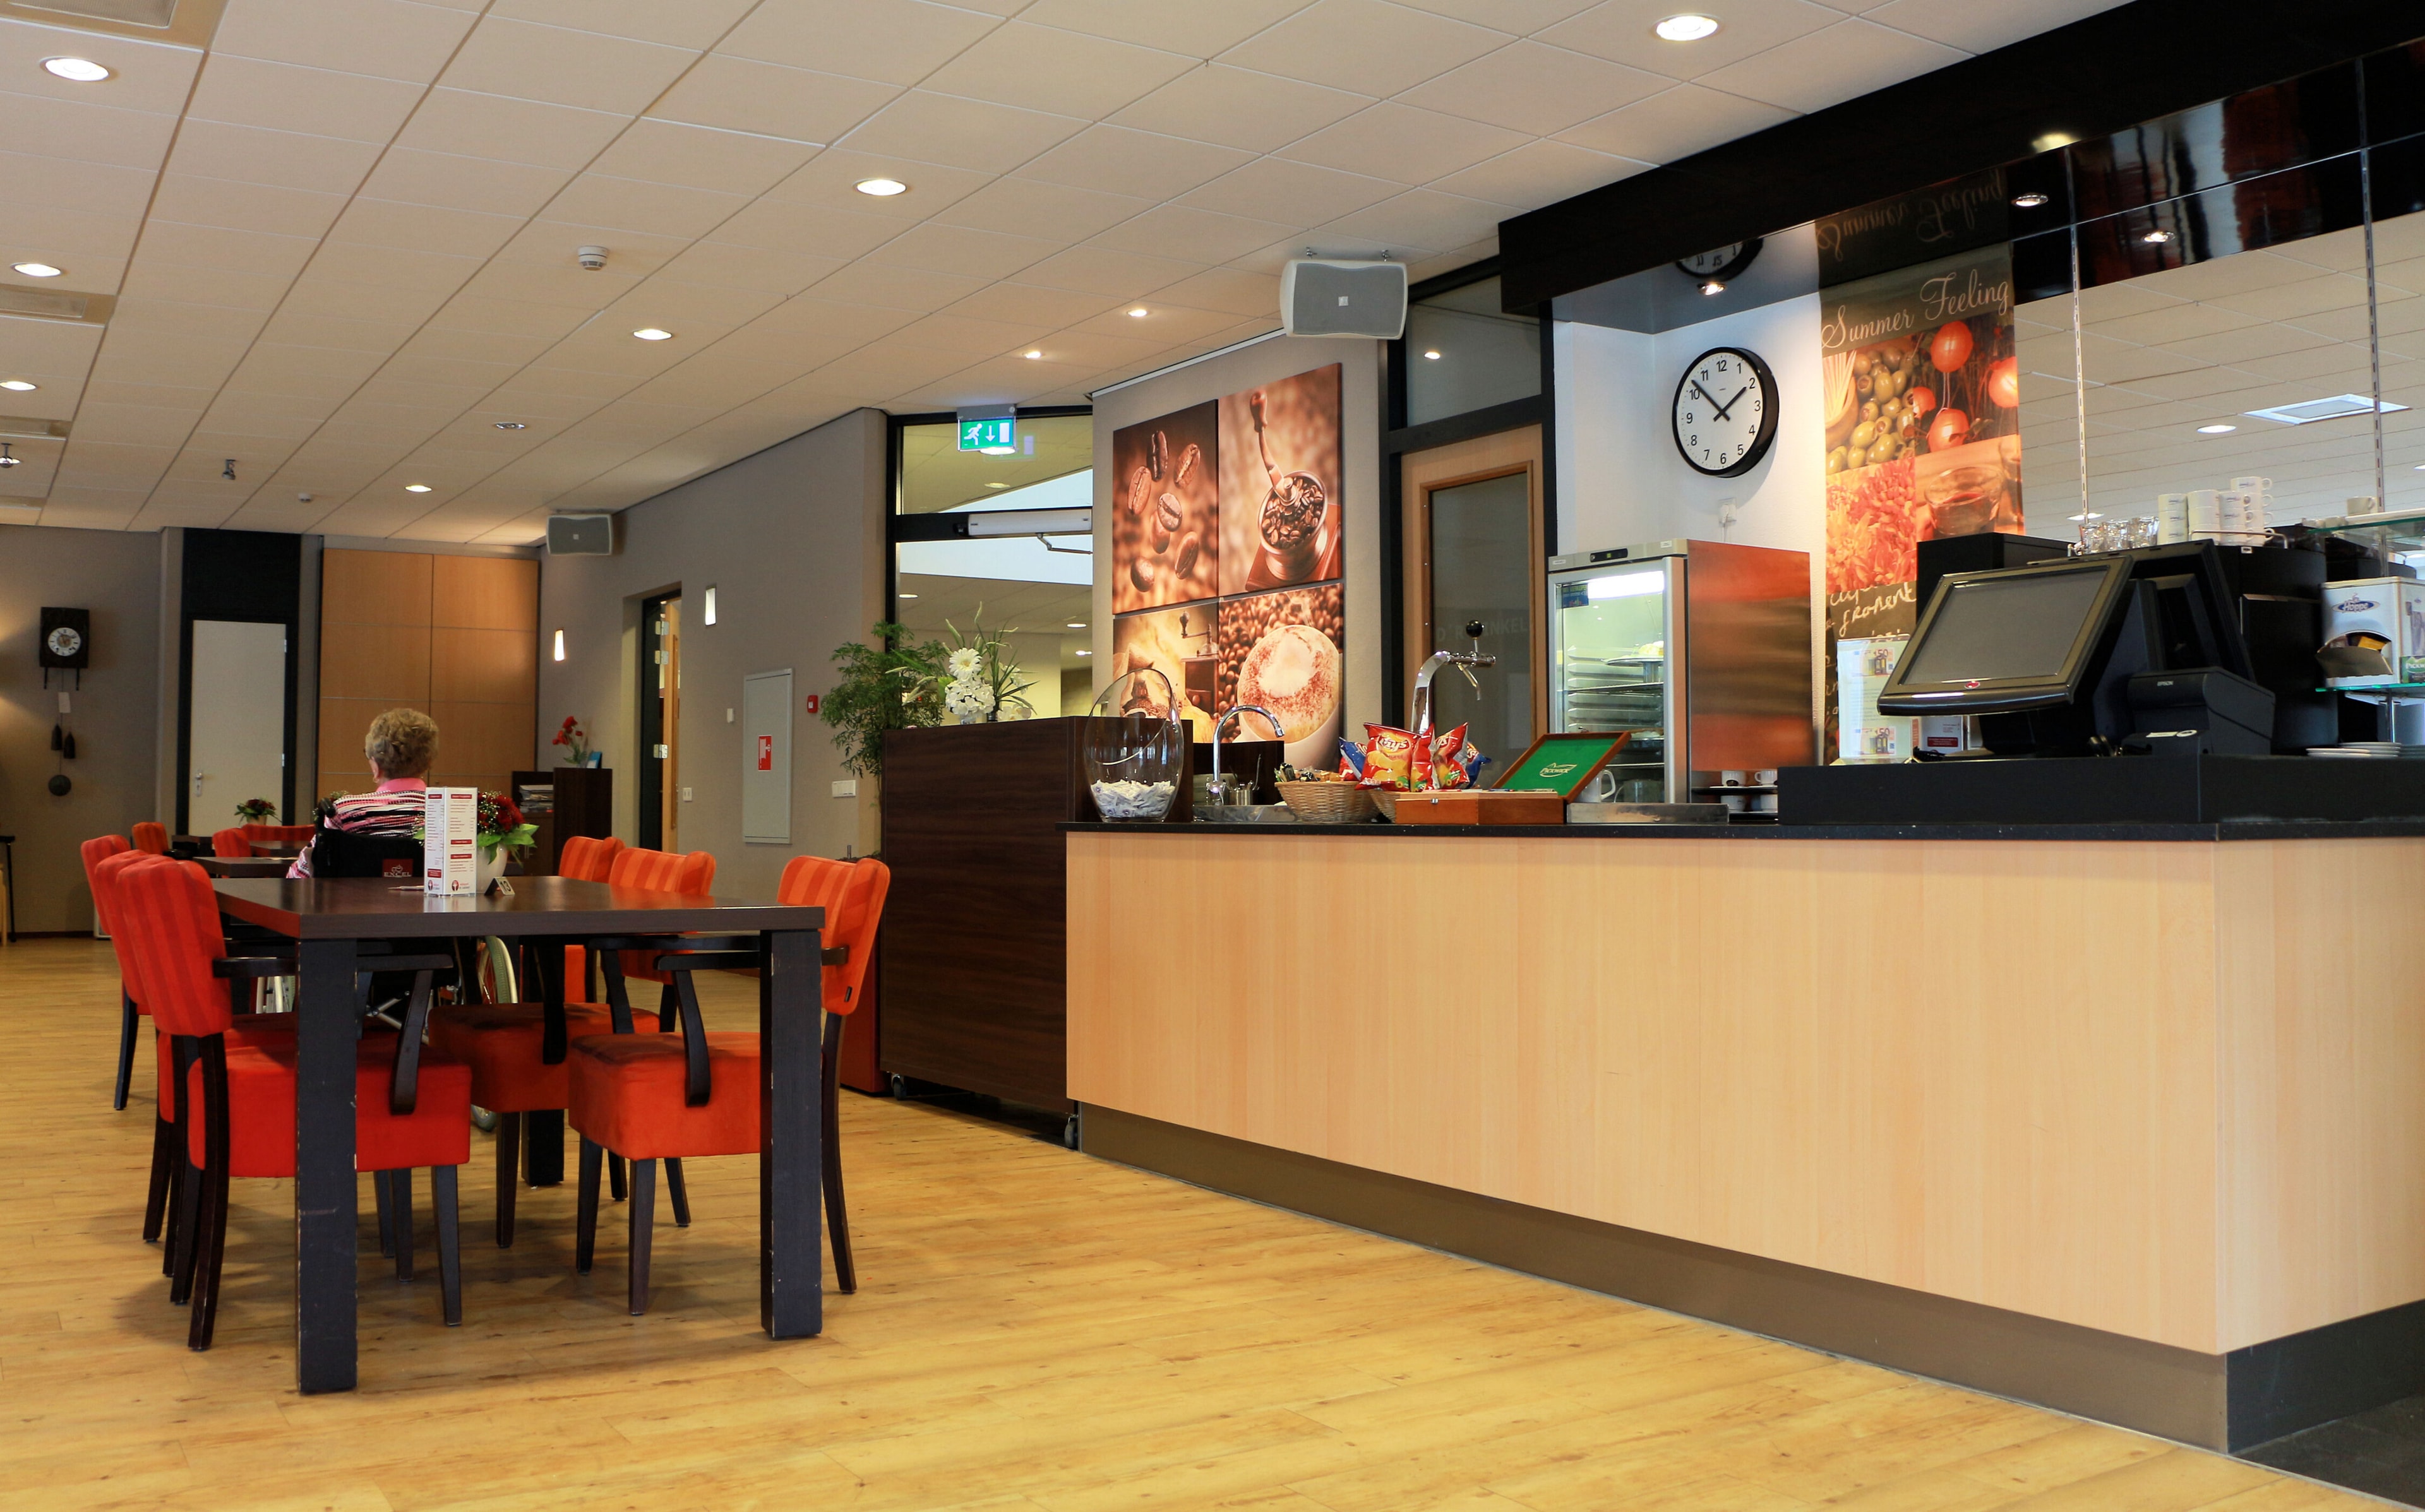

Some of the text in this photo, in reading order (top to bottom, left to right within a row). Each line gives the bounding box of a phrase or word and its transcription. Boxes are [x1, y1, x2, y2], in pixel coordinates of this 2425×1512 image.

[1821, 269, 2009, 349] Summer Feeling
[1716, 360, 1727, 372] 12
[1737, 362, 1742, 374] 1
[1701, 369, 1709, 381] 11
[1749, 378, 1756, 390] 2
[1689, 389, 1700, 400] 10
[1754, 400, 1761, 412] 3
[1686, 412, 1693, 424] 9
[1749, 425, 1756, 436] 4
[1691, 434, 1698, 446] 8
[1703, 449, 1710, 461] 7
[1737, 444, 1744, 456] 5
[1720, 453, 1727, 464] 6
[2342, 600, 2369, 613] Hoppe
[1876, 649, 1888, 658] 50
[1877, 728, 1890, 737] 50
